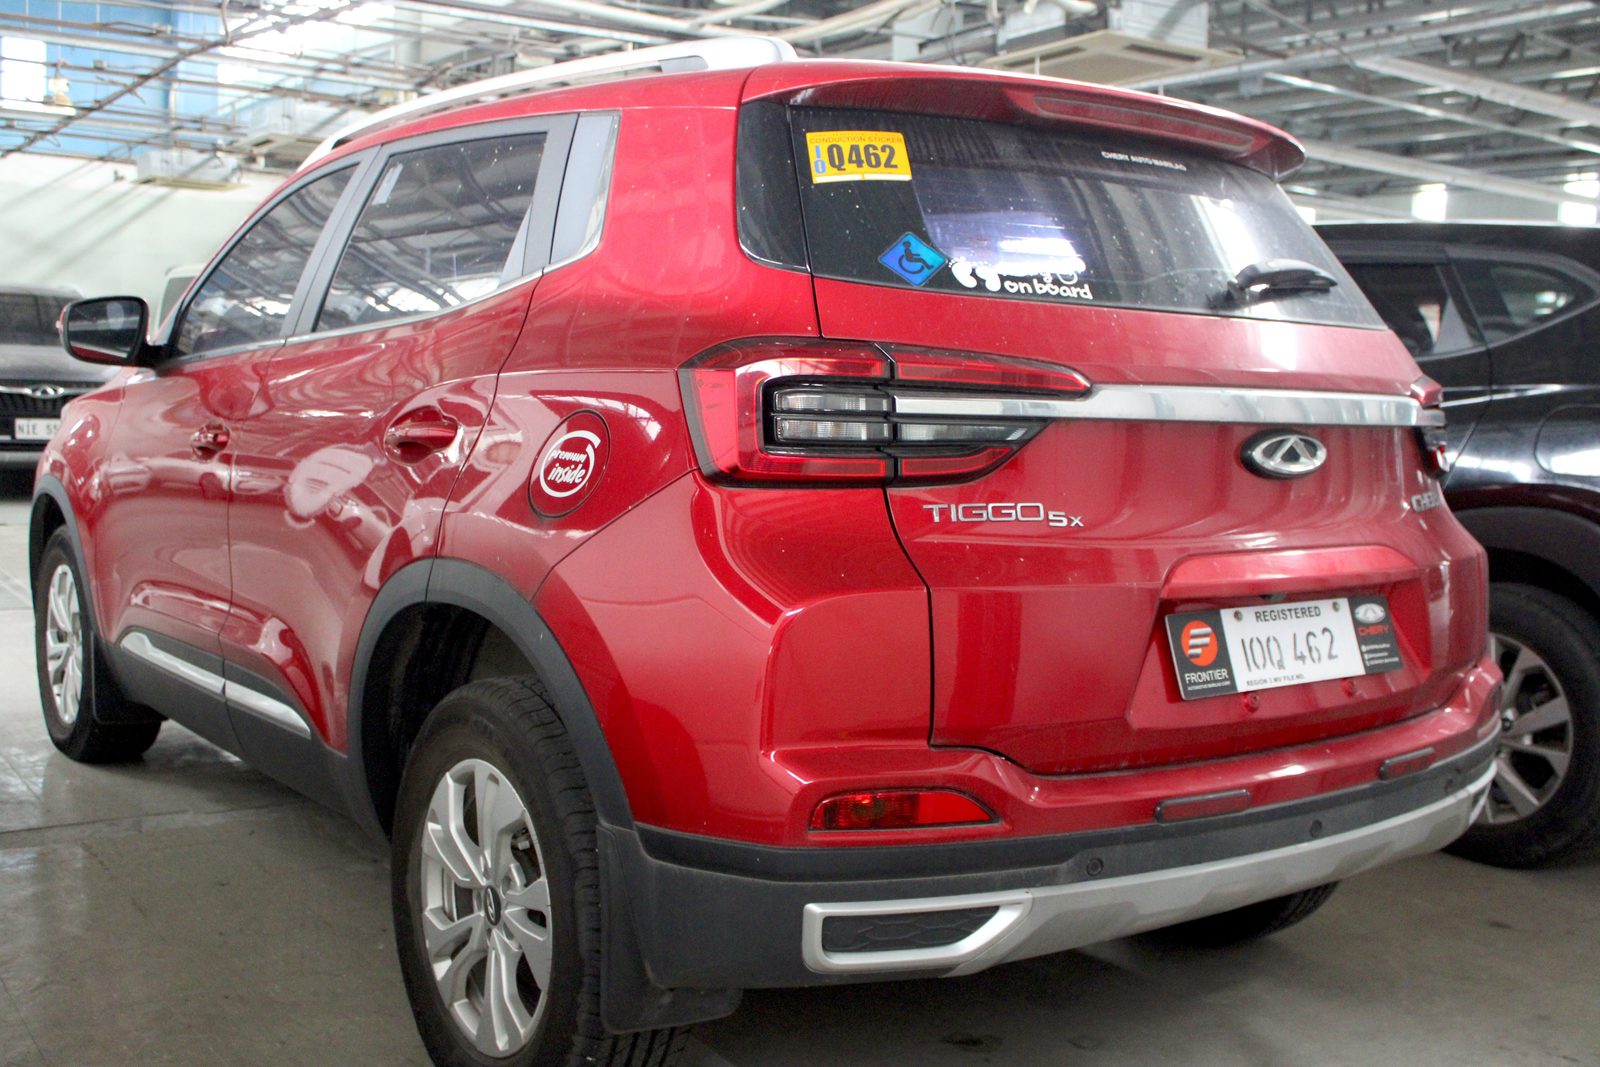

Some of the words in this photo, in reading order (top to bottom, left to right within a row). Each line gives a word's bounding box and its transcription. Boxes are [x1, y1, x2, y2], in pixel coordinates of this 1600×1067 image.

[827, 144, 898, 171] Q462
[1003, 280, 1033, 294] on
[1033, 279, 1093, 300] board
[547, 463, 585, 484] inside
[922, 502, 1045, 523] TIGGO
[1254, 605, 1322, 623] REGISTERED
[1293, 626, 1339, 665] 462
[1184, 668, 1229, 685] FRONTIER
